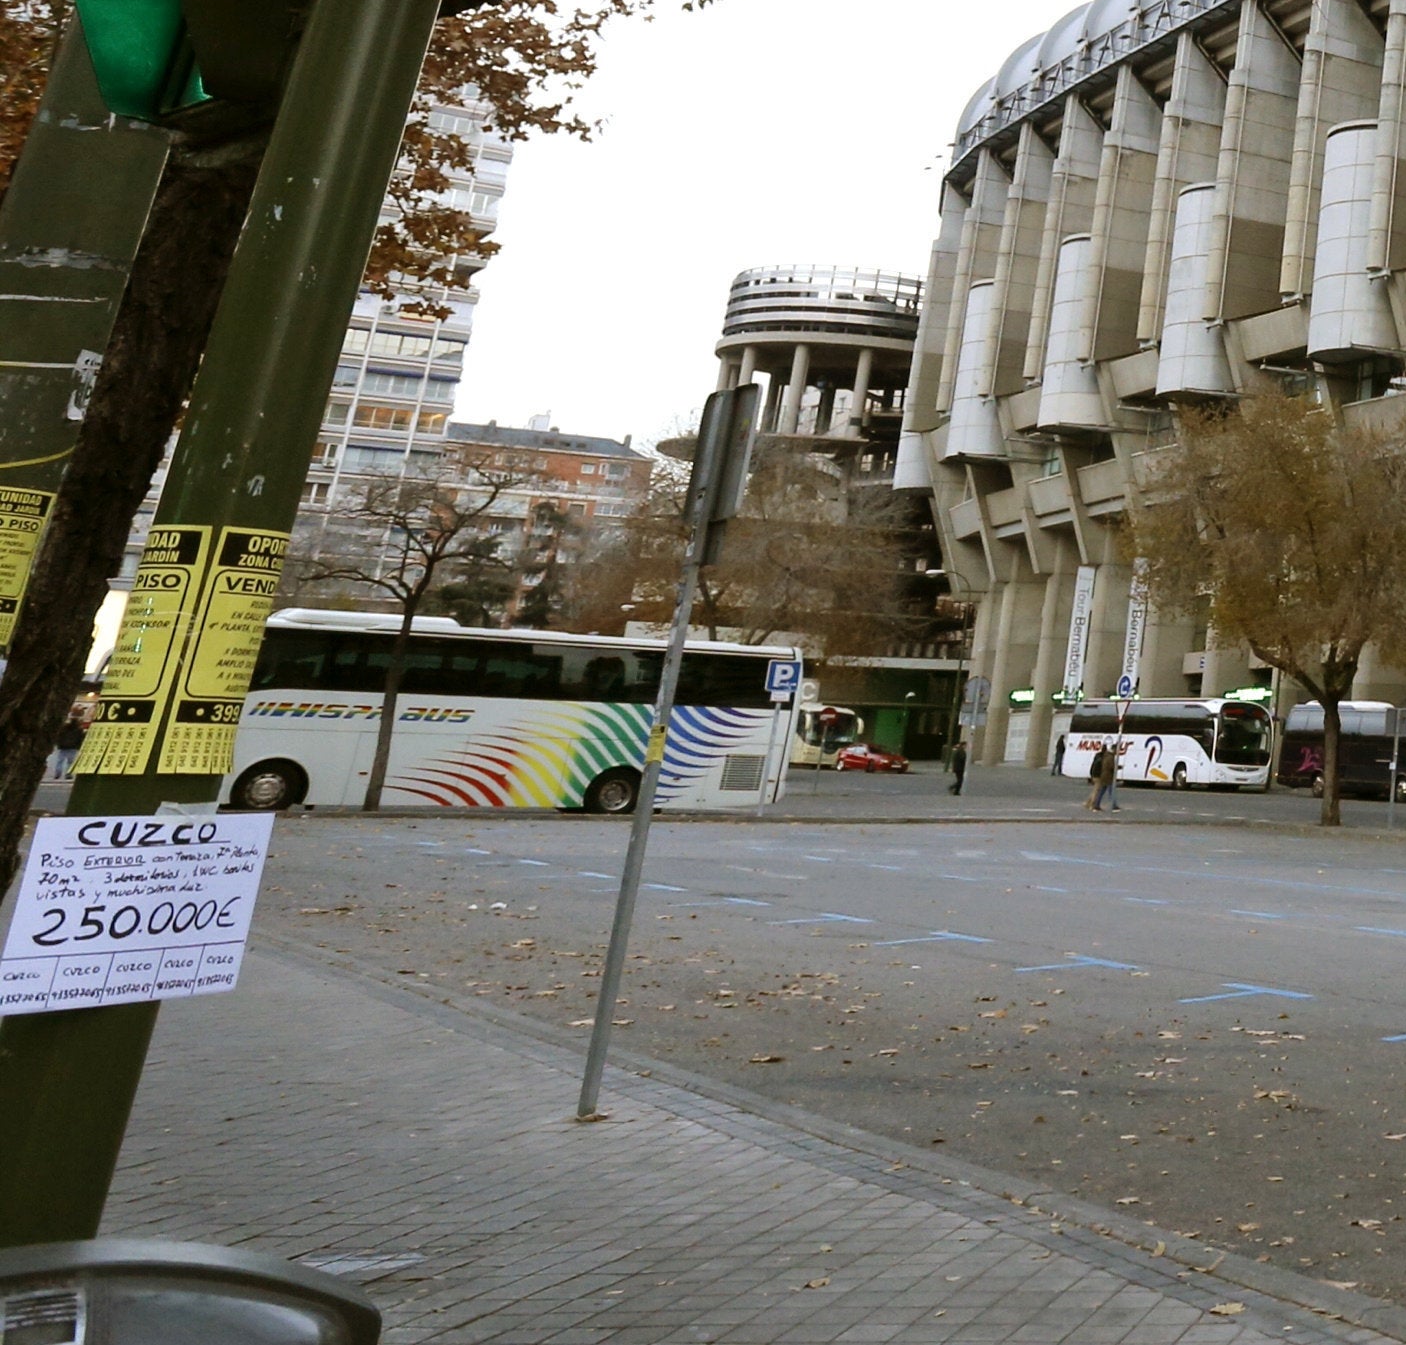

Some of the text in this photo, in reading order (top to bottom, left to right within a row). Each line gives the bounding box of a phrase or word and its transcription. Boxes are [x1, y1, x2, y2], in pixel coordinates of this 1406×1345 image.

[9, 520, 39, 531] PISO
[238, 554, 270, 568] ZONA
[136, 574, 181, 588] PISO
[773, 664, 794, 687] P
[399, 706, 475, 723] BUS
[78, 820, 217, 846] CUZCO
[40, 853, 75, 869] Piso
[84, 854, 146, 866] EXTERIOR
[36, 886, 86, 901] vistas
[32, 896, 241, 946] 250.000€
